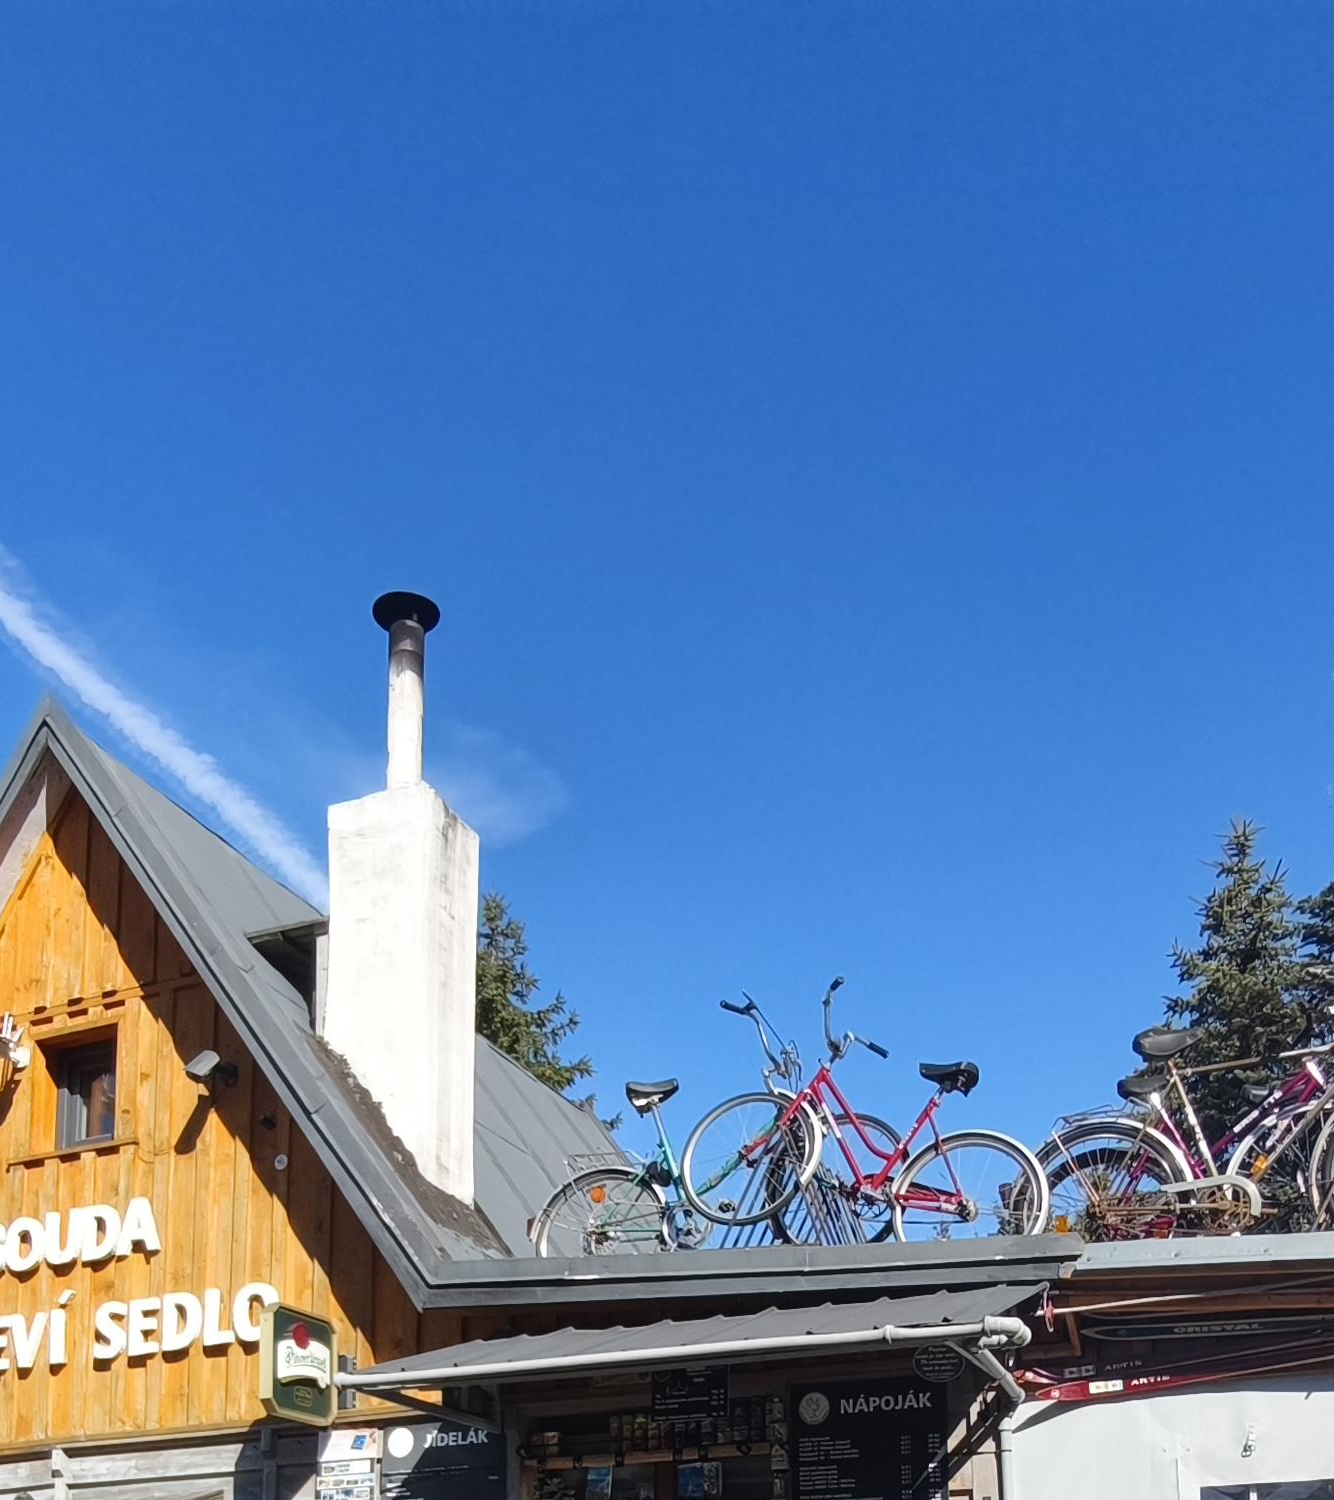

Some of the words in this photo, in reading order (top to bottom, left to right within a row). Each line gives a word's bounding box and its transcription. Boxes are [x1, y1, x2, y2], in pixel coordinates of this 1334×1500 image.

[94, 1282, 280, 1360] SEDLO
[840, 1391, 932, 1415] NÁPOJÁK
[424, 1427, 489, 1448] JÍDELÁK
